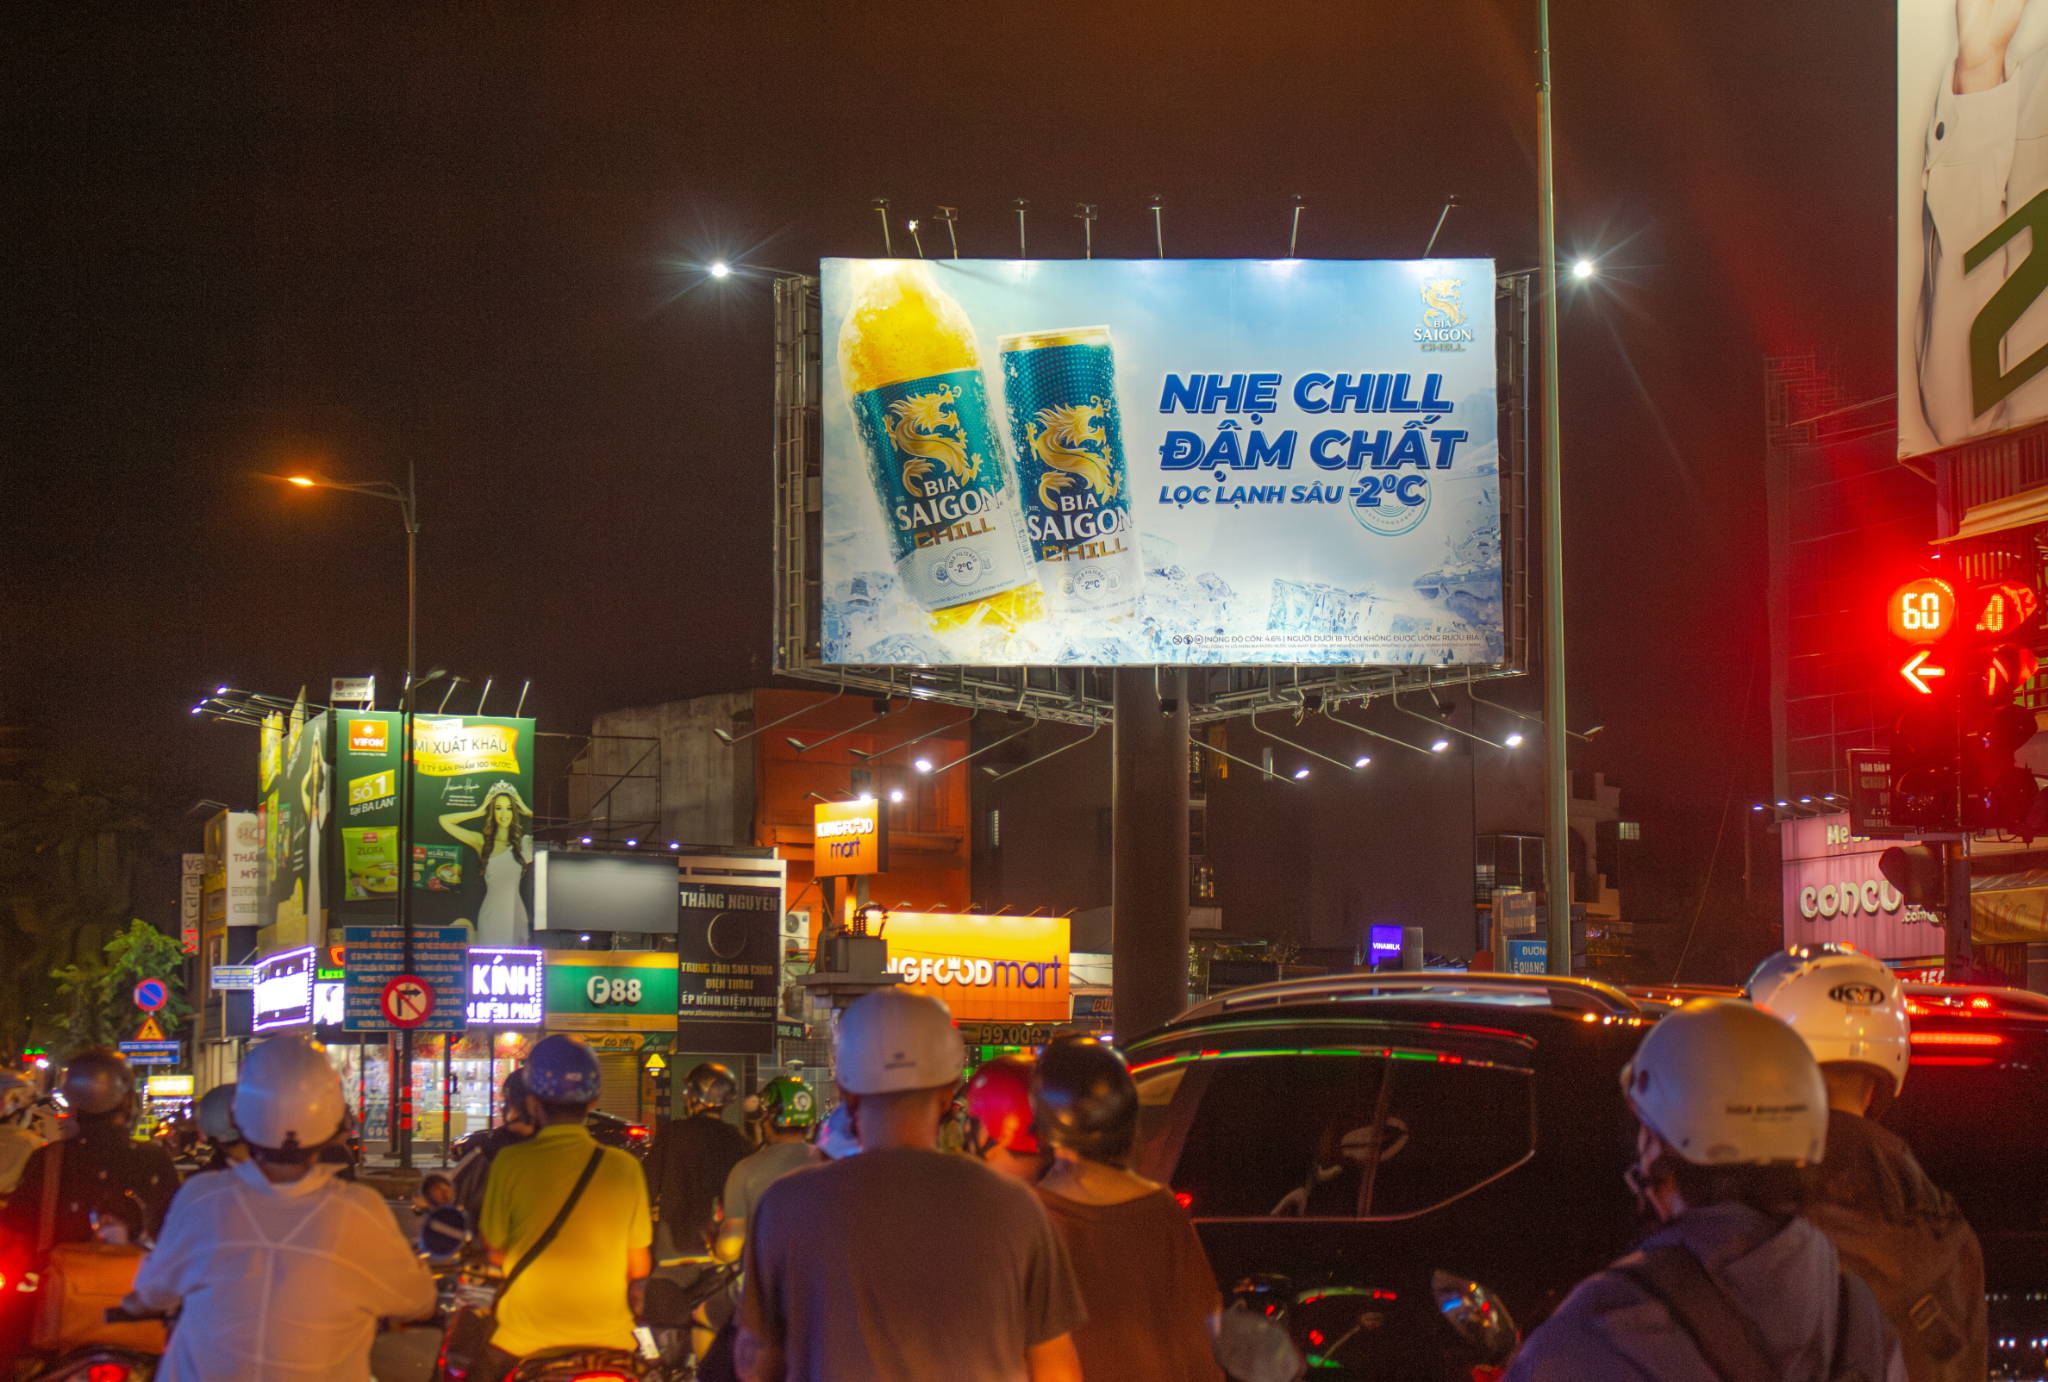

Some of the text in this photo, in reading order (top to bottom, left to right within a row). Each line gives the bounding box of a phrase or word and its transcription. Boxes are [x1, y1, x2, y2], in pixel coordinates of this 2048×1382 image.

[1434, 320, 1452, 328] BIA
[1413, 328, 1472, 342] SAIGON
[1421, 343, 1466, 351] CHILL
[1158, 372, 1454, 425] NHẸ CHILL
[1158, 415, 1469, 483] ĐẬM CHẤT
[923, 476, 961, 497] BIA
[1158, 485, 1211, 509] LỌC
[1215, 485, 1286, 509] LẠNH
[1290, 480, 1344, 504] SÂU
[895, 484, 1000, 531] SAIGON
[1060, 492, 1100, 512] BIA
[913, 517, 996, 549] CHILL
[1027, 503, 1133, 542] SAIGON
[1042, 537, 1128, 562] CHILL
[1902, 592, 1939, 630] 60
[1231, 634, 1244, 643] ĐỘ
[1287, 633, 1312, 642] NGƯỜI
[1313, 633, 1334, 642] DƯỚI
[1343, 633, 1362, 642] TUỔI
[1363, 634, 1392, 642] KHÔNG
[1393, 634, 1417, 642] ĐƯỢC
[1418, 633, 1441, 642] UỐNG
[1442, 634, 1465, 642] RƯỢU
[353, 737, 384, 748] VIFON
[414, 730, 508, 754] MÌ XUẤT KHẨU
[454, 760, 475, 771] PHẨM
[490, 760, 512, 769] NƯỚC
[375, 774, 387, 796] 1
[362, 801, 375, 813] BA
[375, 797, 395, 810] LAN
[816, 817, 874, 838] KINGFOOD
[1827, 824, 1849, 850] Mẹ
[830, 836, 861, 859] mart
[680, 884, 725, 909] THẮNG
[1372, 942, 1401, 950] VINAMILK
[1522, 945, 1546, 956] ĐƯỜN
[472, 954, 536, 996] KÍNH
[681, 962, 710, 974] TRUNG
[1519, 961, 1546, 974] QUANG
[586, 975, 642, 1005] F88
[705, 976, 726, 993] ĐIỆN
[681, 990, 695, 1005] ÉP
[695, 991, 721, 1006] KÍNH
[721, 993, 747, 1010] ĐIỆN
